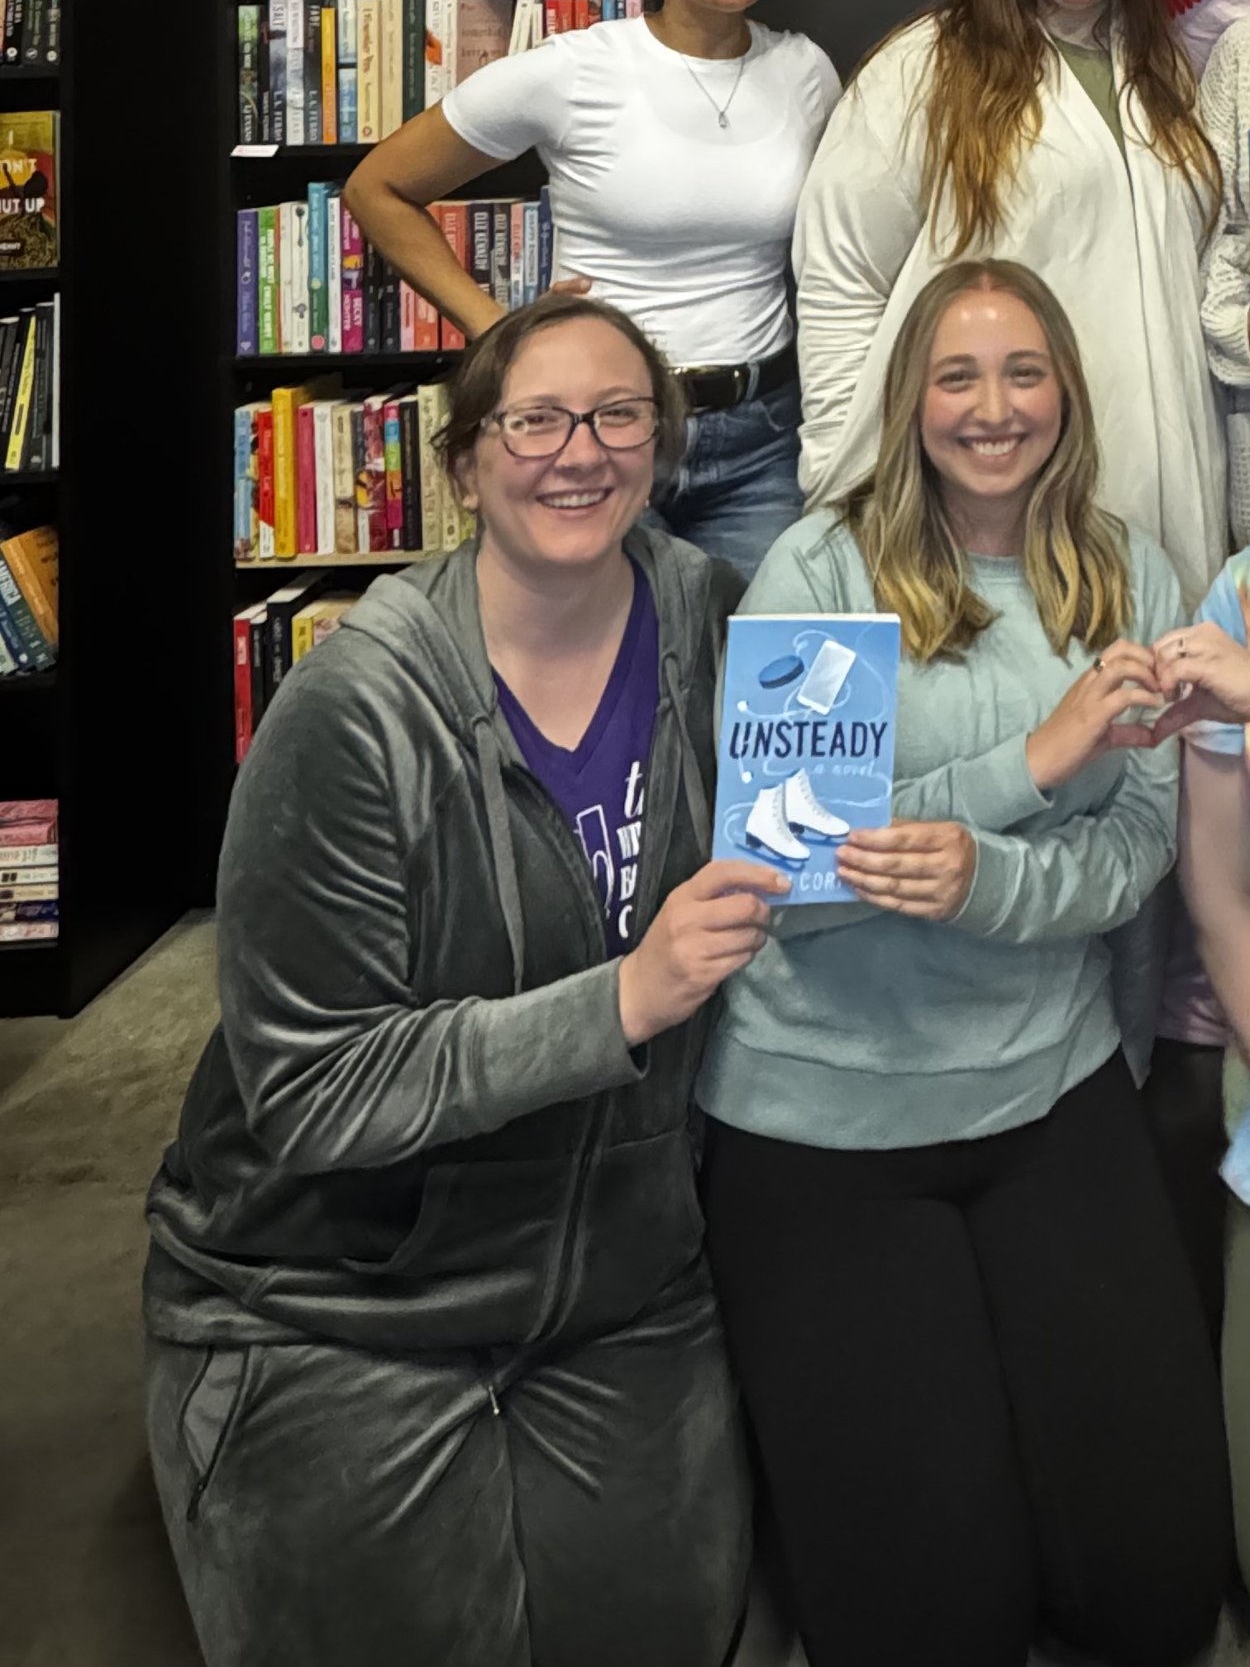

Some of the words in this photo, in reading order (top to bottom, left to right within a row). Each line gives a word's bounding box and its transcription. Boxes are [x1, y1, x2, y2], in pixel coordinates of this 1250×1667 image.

[0, 158, 37, 174] ON'T
[0, 198, 20, 213] UT
[25, 197, 45, 213] UP
[474, 212, 489, 231] ELLE
[474, 232, 489, 270] KENNEDY
[729, 721, 888, 759] UNSTEADY
